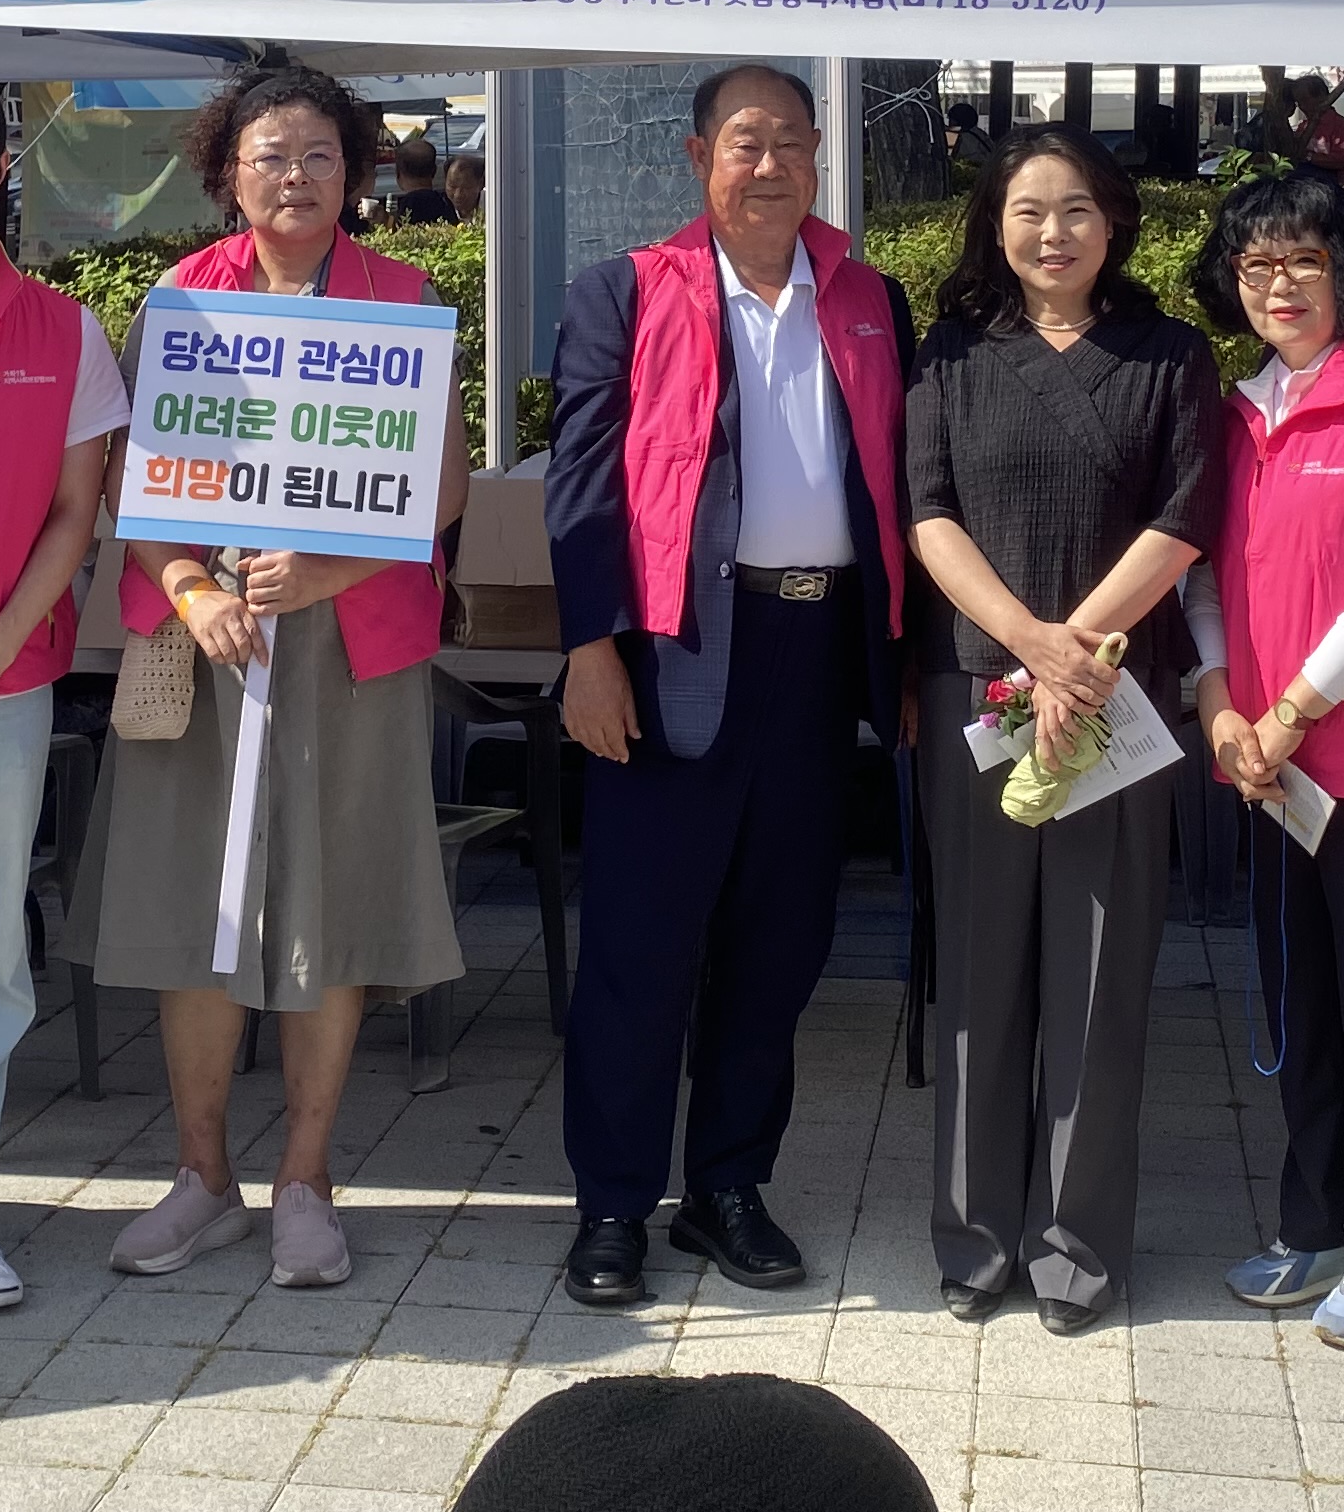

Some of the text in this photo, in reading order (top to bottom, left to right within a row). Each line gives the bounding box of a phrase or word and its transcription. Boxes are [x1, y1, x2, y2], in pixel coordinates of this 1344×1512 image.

[162, 330, 424, 389] 당신의 관심이
[152, 392, 418, 452] 어려운 이웃에
[143, 455, 412, 516] 희망이 됩니다
